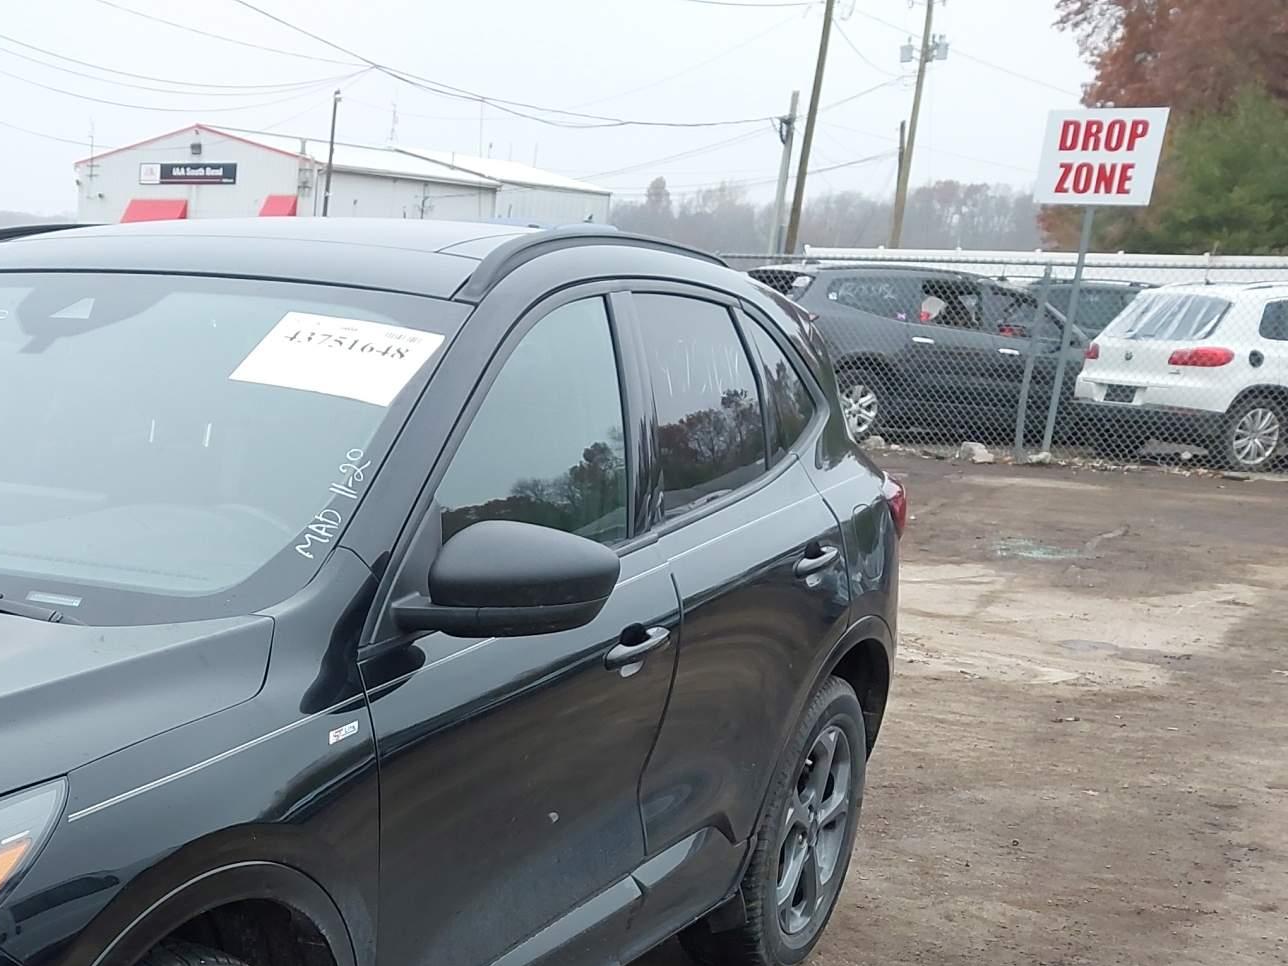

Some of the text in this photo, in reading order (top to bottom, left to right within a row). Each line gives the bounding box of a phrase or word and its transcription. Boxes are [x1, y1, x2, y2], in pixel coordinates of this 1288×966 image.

[1058, 119, 1150, 152] DROP
[186, 167, 205, 176] South
[1054, 162, 1136, 194] ZONE
[284, 330, 410, 360] 43751648
[295, 448, 371, 559] MAD 11-20
